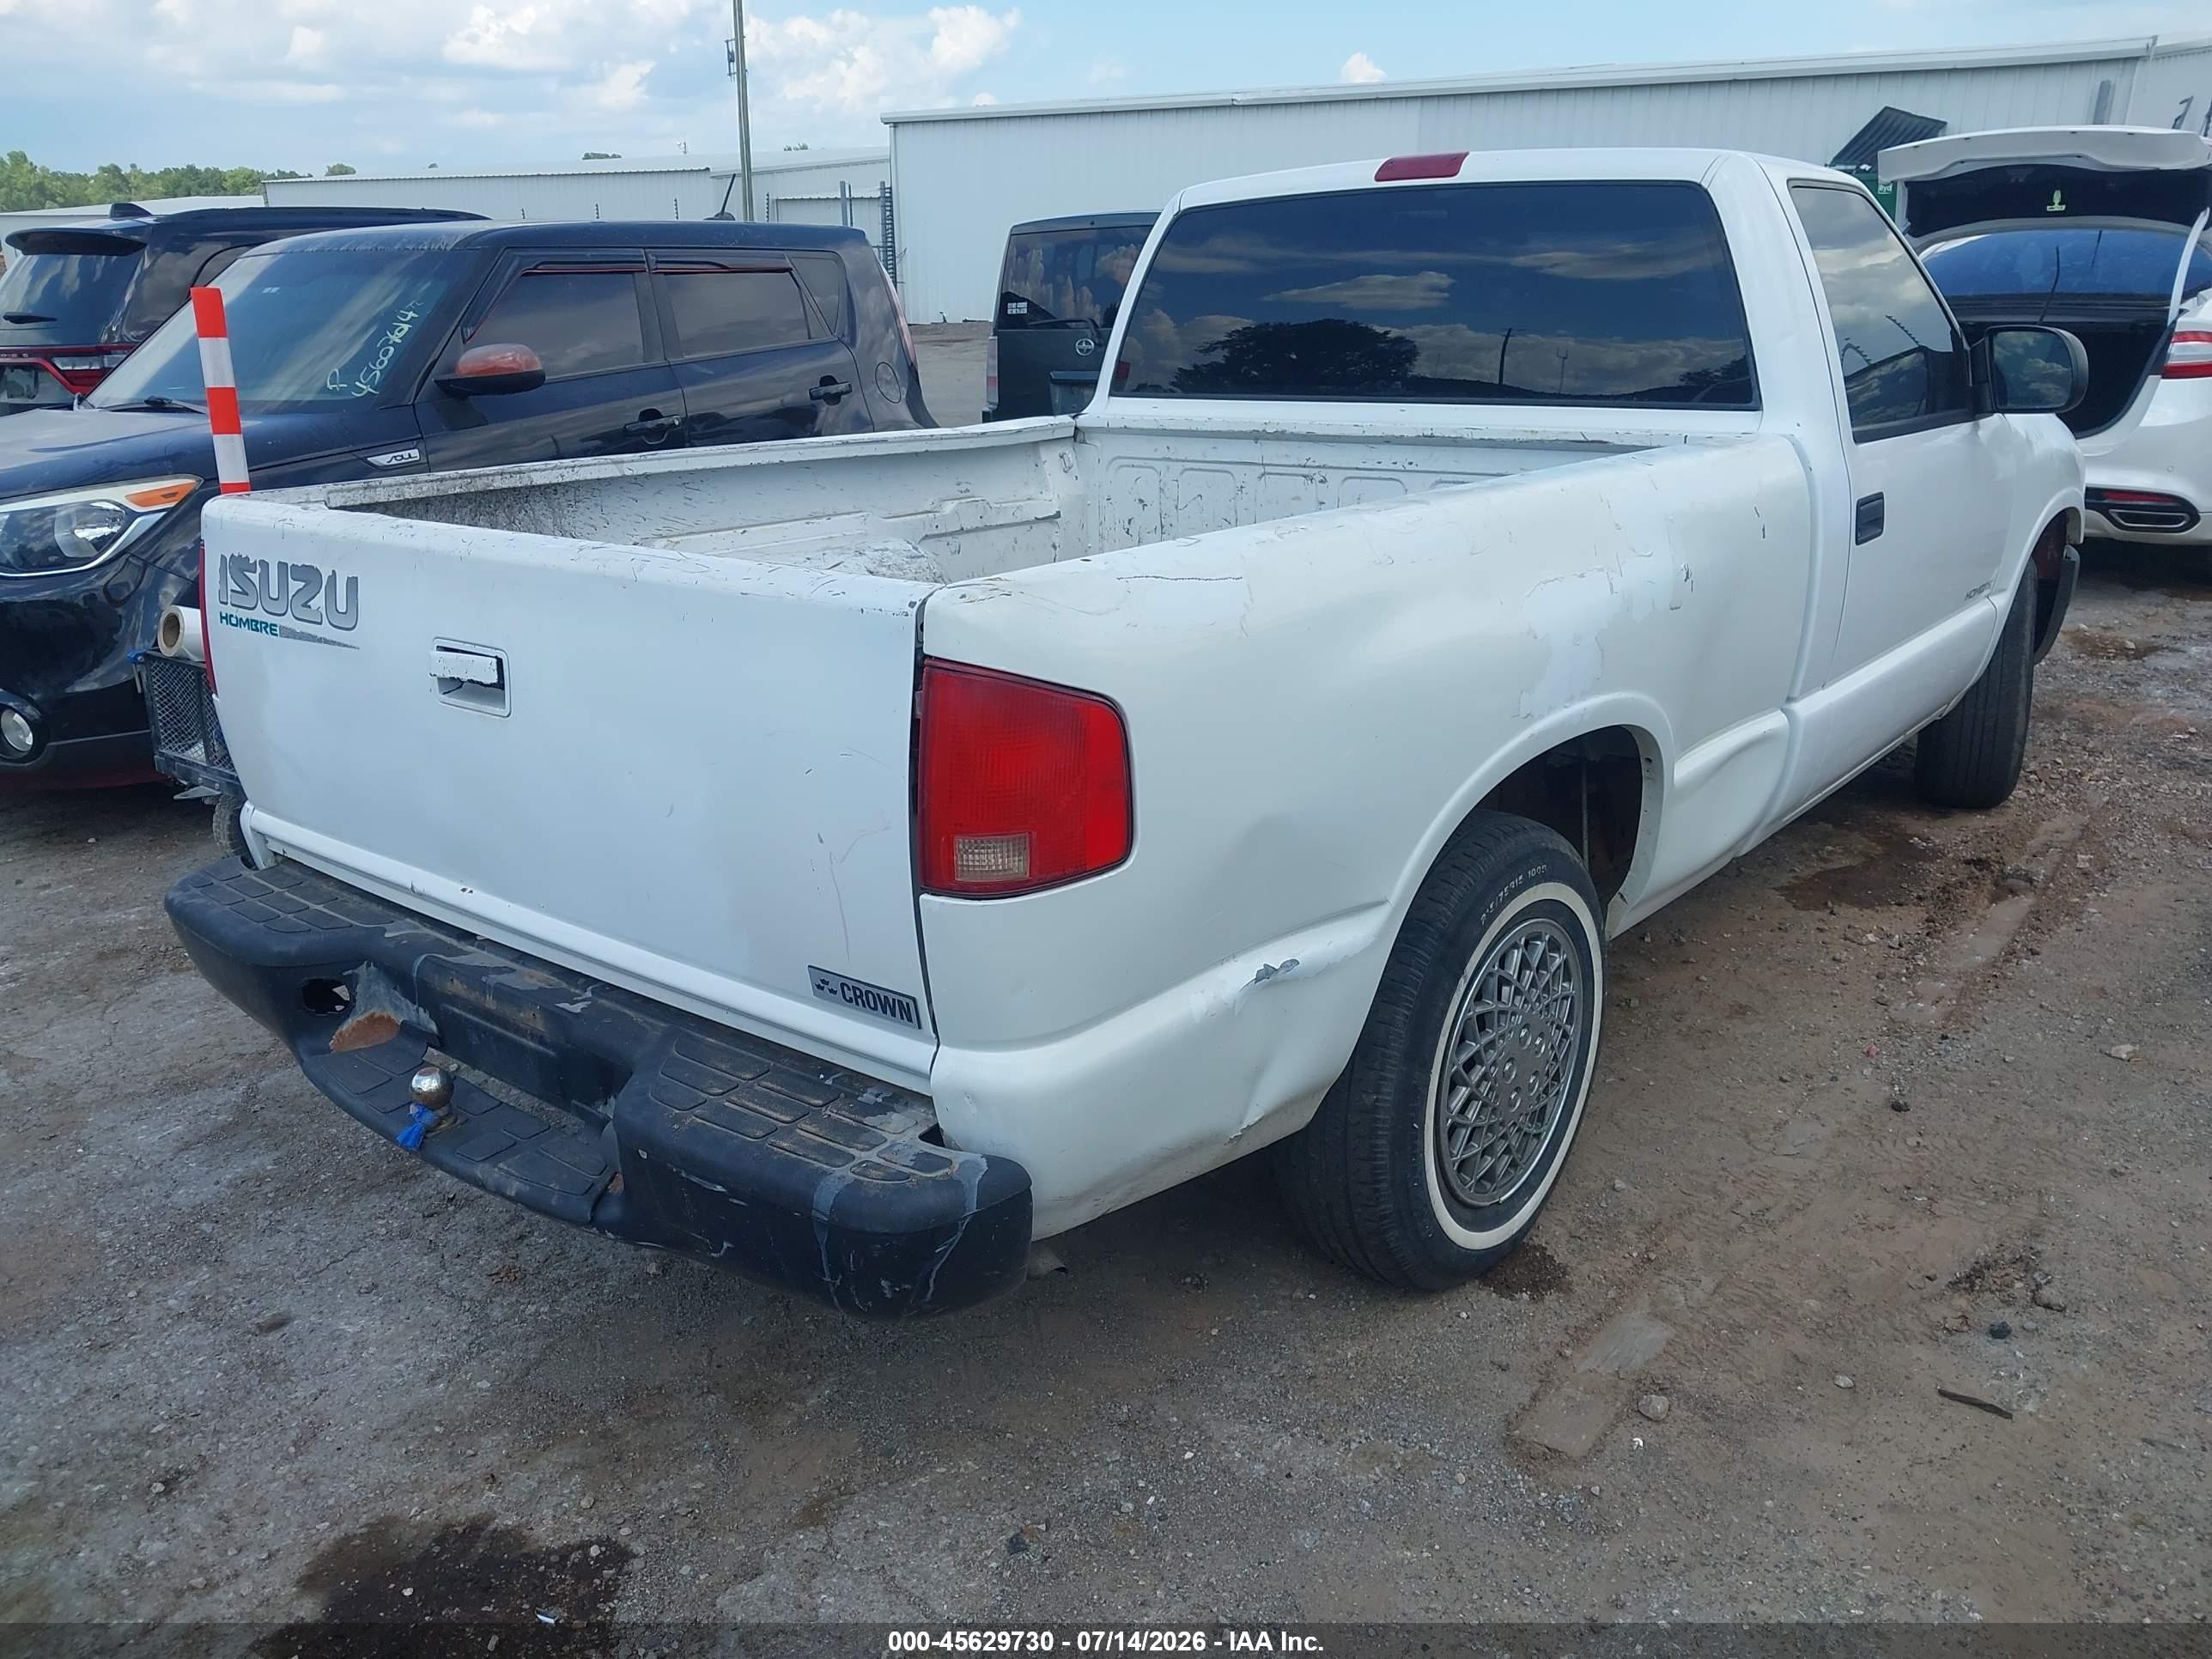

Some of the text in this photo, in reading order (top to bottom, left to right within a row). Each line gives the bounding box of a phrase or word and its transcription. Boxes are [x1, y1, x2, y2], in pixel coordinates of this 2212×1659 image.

[386, 453, 418, 464] SOUL
[218, 552, 359, 632] ISUZU
[219, 611, 279, 637] HOMBRE
[840, 981, 913, 1024] CROWN
